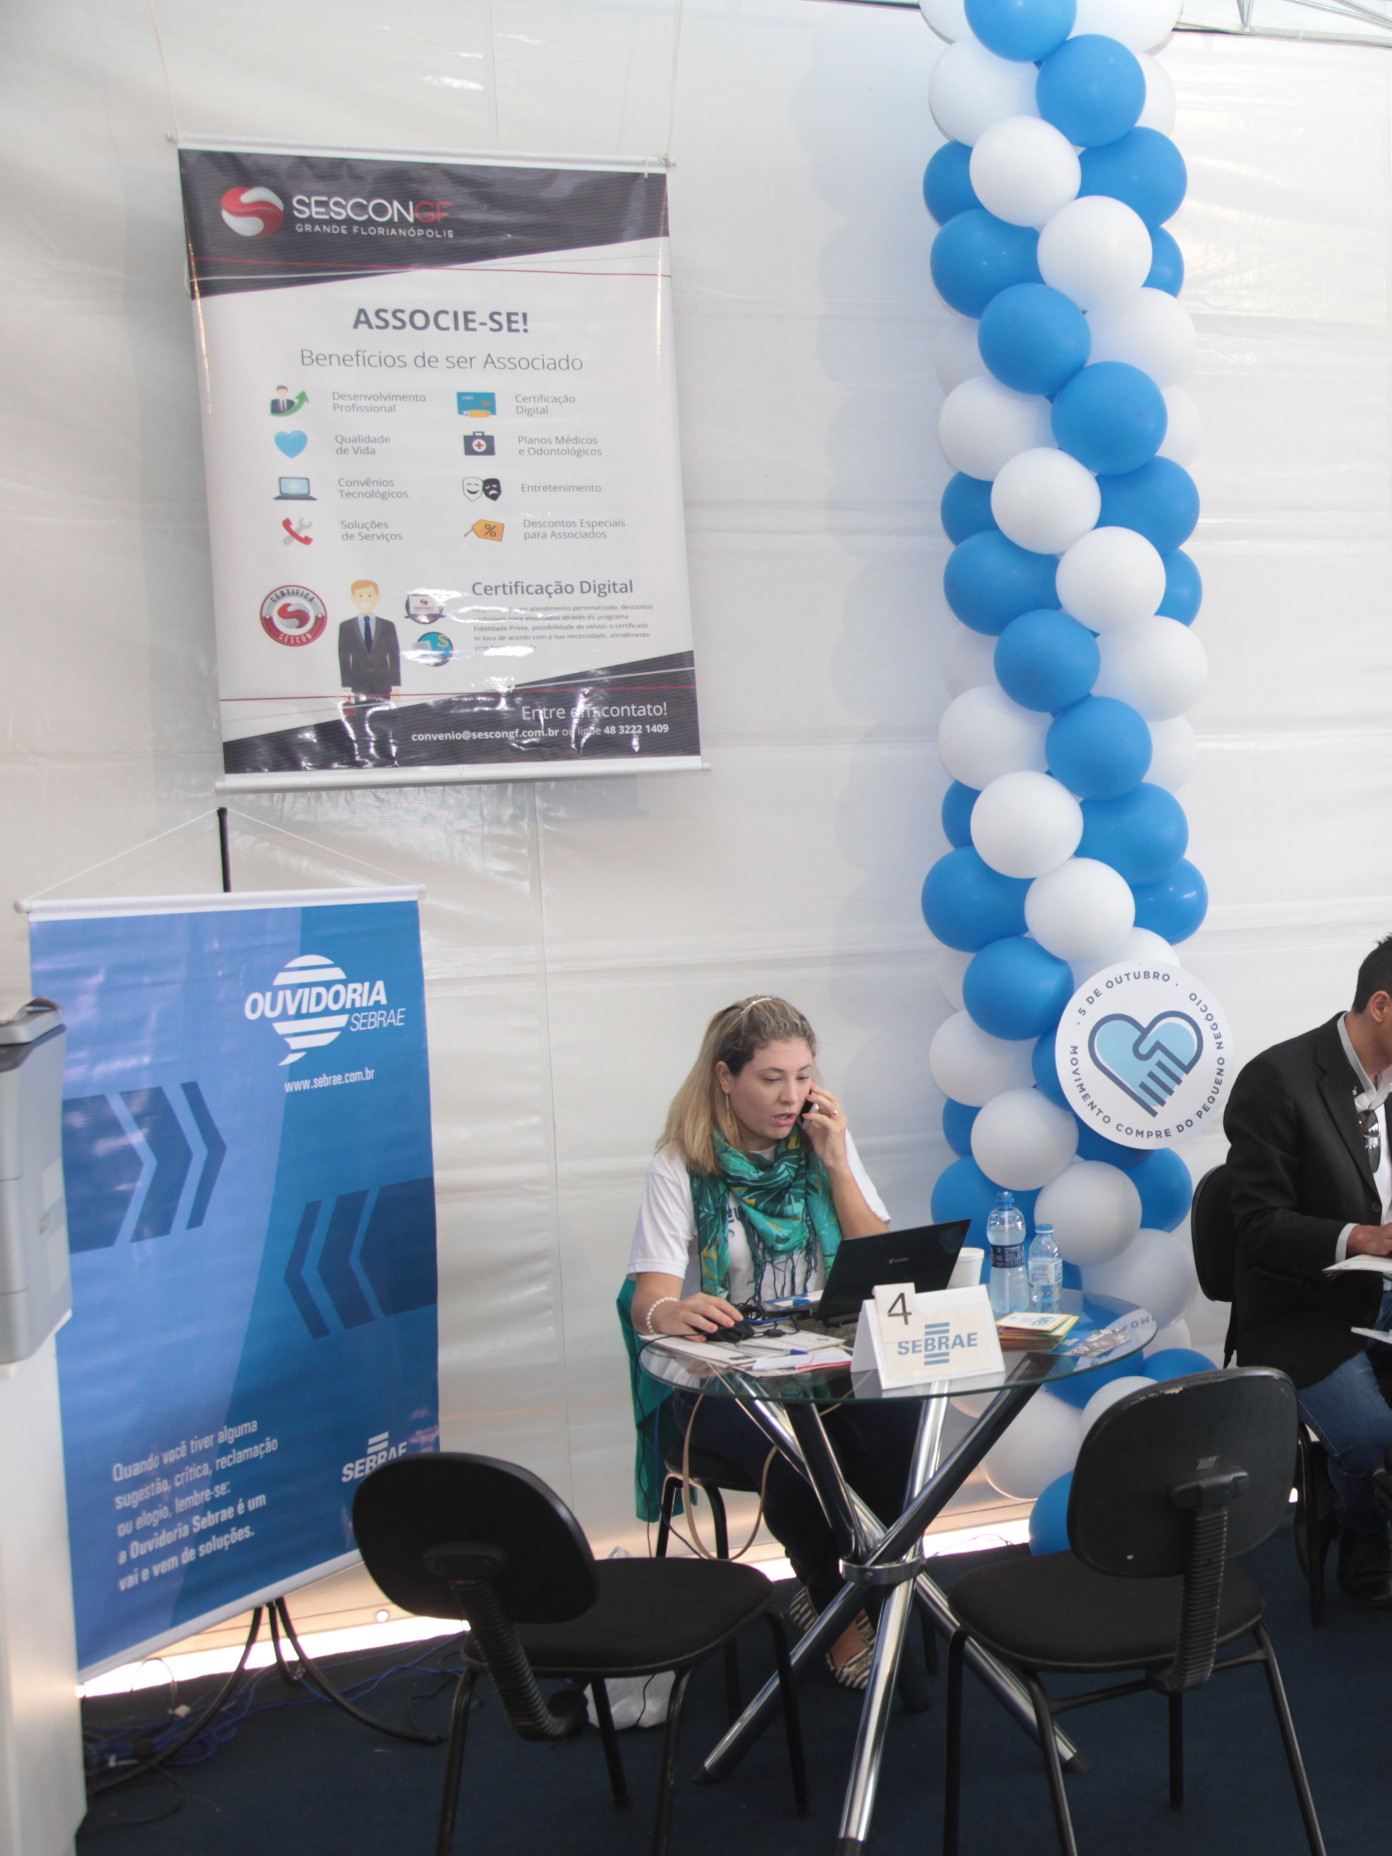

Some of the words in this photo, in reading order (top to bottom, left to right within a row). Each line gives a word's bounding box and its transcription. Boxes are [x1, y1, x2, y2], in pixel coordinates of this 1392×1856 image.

[292, 195, 454, 223] SESCONGF
[296, 224, 348, 234] GRANDE
[353, 226, 454, 239] FLORIANÓPOLIS
[353, 308, 529, 333] ASSOCIE-SE!
[301, 349, 407, 369] Benefícios
[414, 351, 439, 369] de
[446, 355, 477, 370] ser
[483, 352, 583, 371] Associado
[332, 391, 427, 402] Desenvolvimento
[515, 394, 576, 405] Certificação
[333, 403, 396, 413] Profissional
[516, 406, 549, 416] Digital
[334, 434, 391, 445] Qualidade
[518, 436, 552, 445] Planos
[555, 436, 598, 445] Médicos
[336, 446, 349, 455] de
[352, 446, 376, 455] Vida
[527, 446, 602, 458] Odontológicos
[338, 478, 395, 487] Convênios
[521, 483, 602, 493] Entretenimento
[338, 489, 408, 501] Tecnológicos
[341, 520, 389, 531] Soluções
[523, 519, 577, 528] Descontos
[580, 518, 626, 530] Especiais
[342, 531, 355, 541] de
[358, 531, 403, 542] Serviços
[524, 531, 548, 542] para
[550, 530, 607, 539] Associados
[472, 581, 575, 598] Certificação
[580, 580, 633, 598] Digital
[573, 604, 619, 612] personalizado,
[621, 603, 653, 611] descontos
[597, 614, 629, 622] programa
[532, 624, 574, 632] possibilidade
[615, 622, 648, 630] certificado
[279, 632, 312, 643] SESCON
[522, 705, 565, 720] Entre
[602, 702, 668, 718] contato!
[411, 726, 559, 742] convenio@sescongf.com.br
[604, 726, 616, 735] 48
[619, 725, 643, 735] 3222
[646, 724, 669, 733] 1409
[244, 980, 387, 1020] OUVIDORIA
[1078, 1008, 1087, 1016] 5
[1086, 988, 1102, 1005] DE
[1105, 971, 1171, 989] OUTUBRO
[350, 1008, 406, 1032] SEBRAE
[1189, 992, 1224, 1051] NEGÓCIO
[284, 1067, 375, 1093] www.sebrae.com.br
[1070, 1045, 1111, 1124] MOVIMENTO
[1196, 1056, 1225, 1119] PEQUENO
[1115, 1123, 1172, 1139] COMPRE
[1176, 1119, 1194, 1133] DO
[887, 1292, 912, 1326] 4
[897, 1332, 978, 1356] SEBRAE
[112, 1454, 160, 1482] Quando
[162, 1440, 187, 1464] você
[190, 1433, 215, 1454] tiver
[218, 1419, 258, 1444] alguma
[341, 1441, 408, 1483] SEBRAE
[115, 1478, 172, 1510] sugestão,
[174, 1463, 212, 1487] crítica,
[215, 1437, 278, 1471] reclamação
[117, 1520, 133, 1537] ou
[135, 1504, 172, 1531] elogio,
[175, 1481, 231, 1514] lembre-se:
[118, 1550, 127, 1565] a
[130, 1522, 189, 1559] Ouvidoria
[192, 1506, 235, 1533] Sebrae
[237, 1498, 245, 1515] é
[248, 1493, 266, 1511] um
[119, 1568, 139, 1592] vai
[141, 1568, 149, 1582] e
[152, 1556, 178, 1577] vem
[181, 1546, 196, 1565] de
[198, 1526, 255, 1558] soluções.
